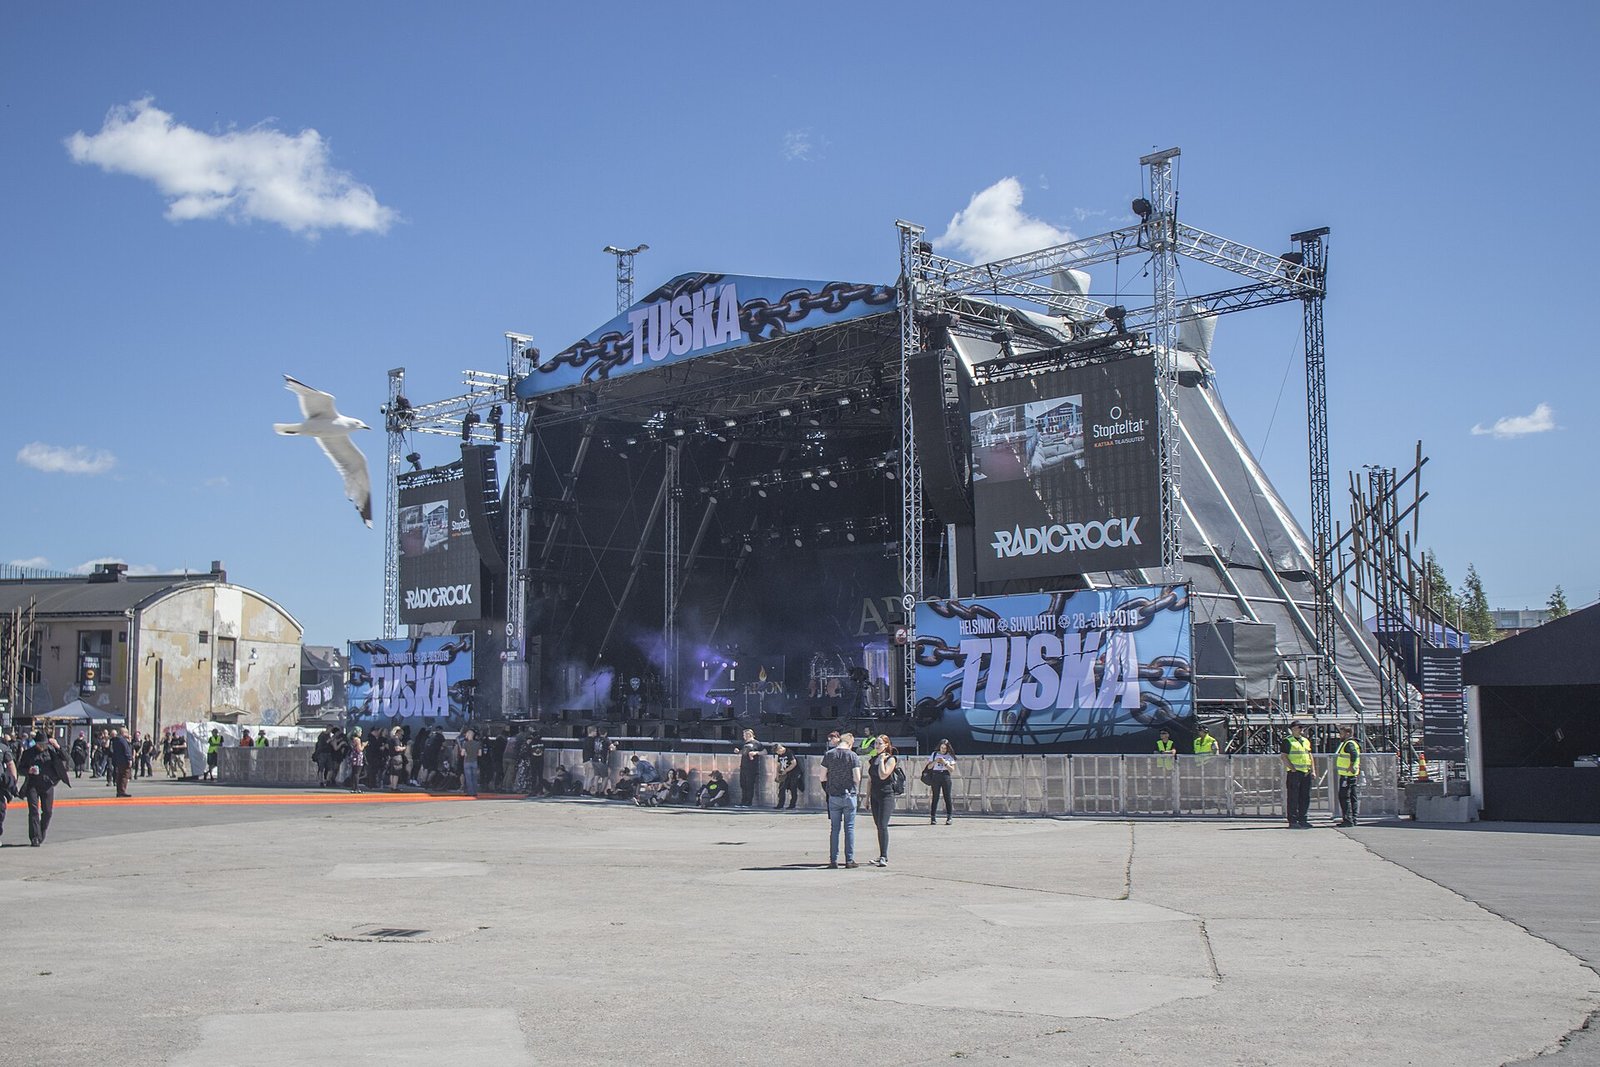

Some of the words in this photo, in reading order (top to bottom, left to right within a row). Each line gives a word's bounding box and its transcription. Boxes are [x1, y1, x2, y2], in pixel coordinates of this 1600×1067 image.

[628, 283, 742, 365] TUSKA
[1093, 418, 1144, 439] Stopteltat
[959, 618, 996, 635] HELSINKI
[1010, 614, 1057, 632] SUVILAHTI
[364, 664, 450, 718] TUSKA
[942, 630, 1141, 711] TUSKA
